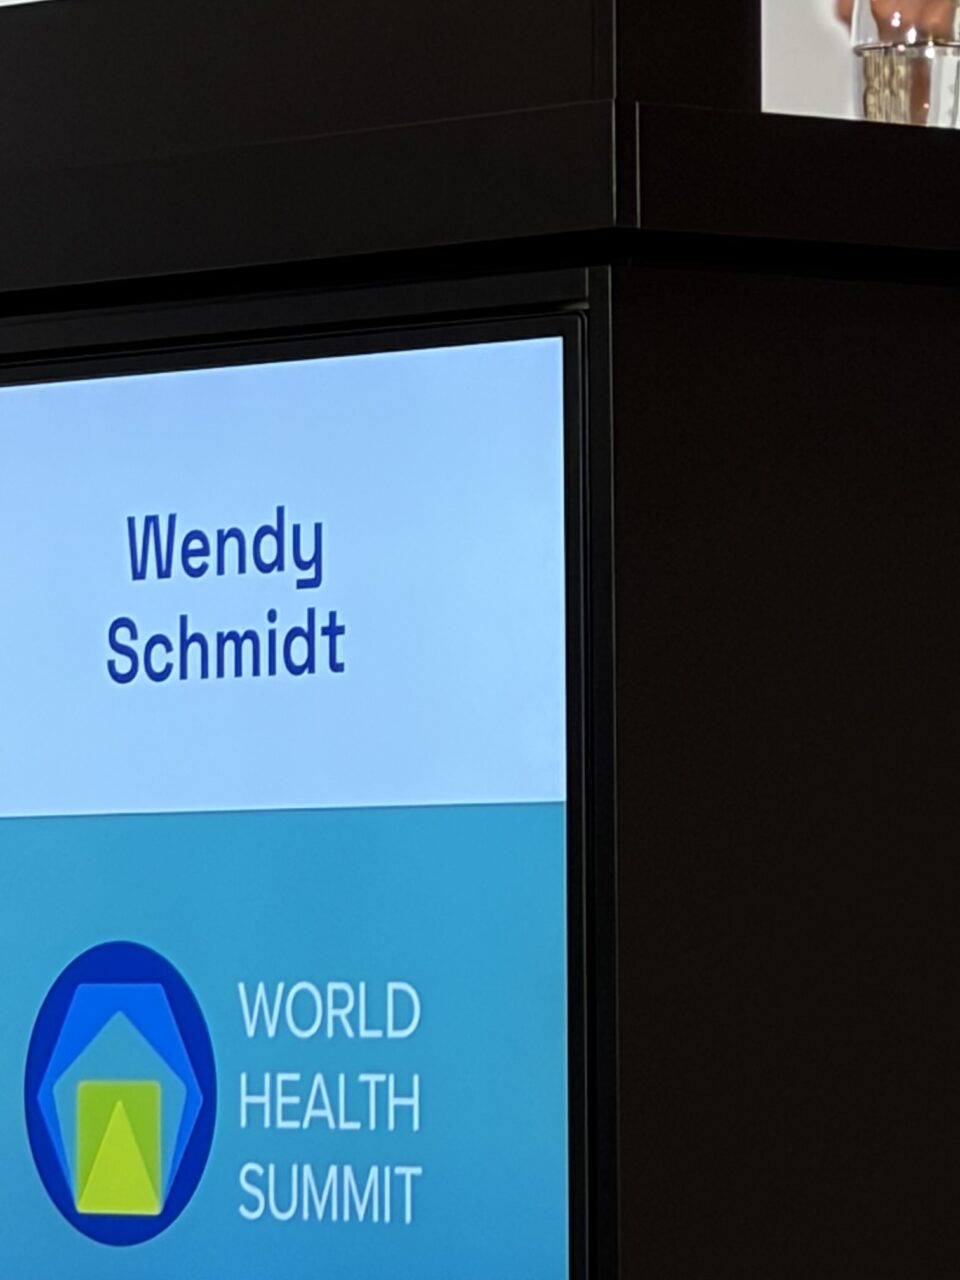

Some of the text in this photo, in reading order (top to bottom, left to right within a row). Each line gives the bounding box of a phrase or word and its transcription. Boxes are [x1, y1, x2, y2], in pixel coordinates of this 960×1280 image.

[126, 505, 323, 590] Wendy
[106, 606, 346, 685] Schmidt
[238, 981, 421, 1038] WORLD
[239, 1073, 420, 1131] HEALTH
[239, 1163, 423, 1224] SUMMIT
